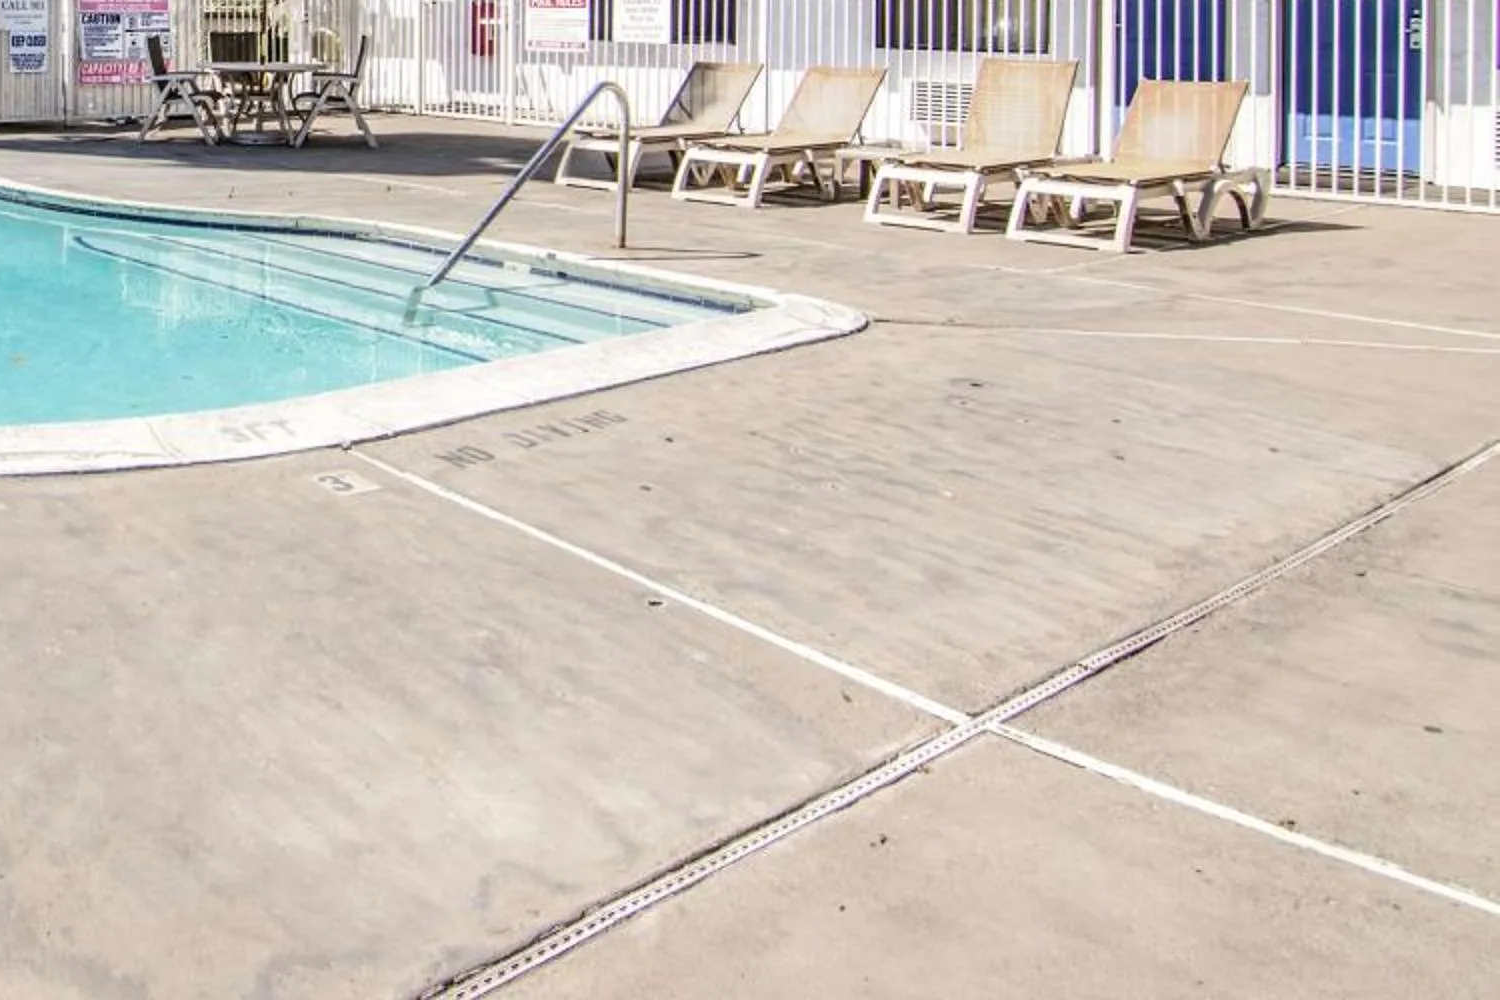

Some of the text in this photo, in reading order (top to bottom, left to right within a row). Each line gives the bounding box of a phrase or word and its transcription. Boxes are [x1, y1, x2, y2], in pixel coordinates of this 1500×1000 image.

[1, 1, 28, 10] CALL
[81, 13, 121, 25] CAUTION
[435, 408, 629, 470] NO DIVING
